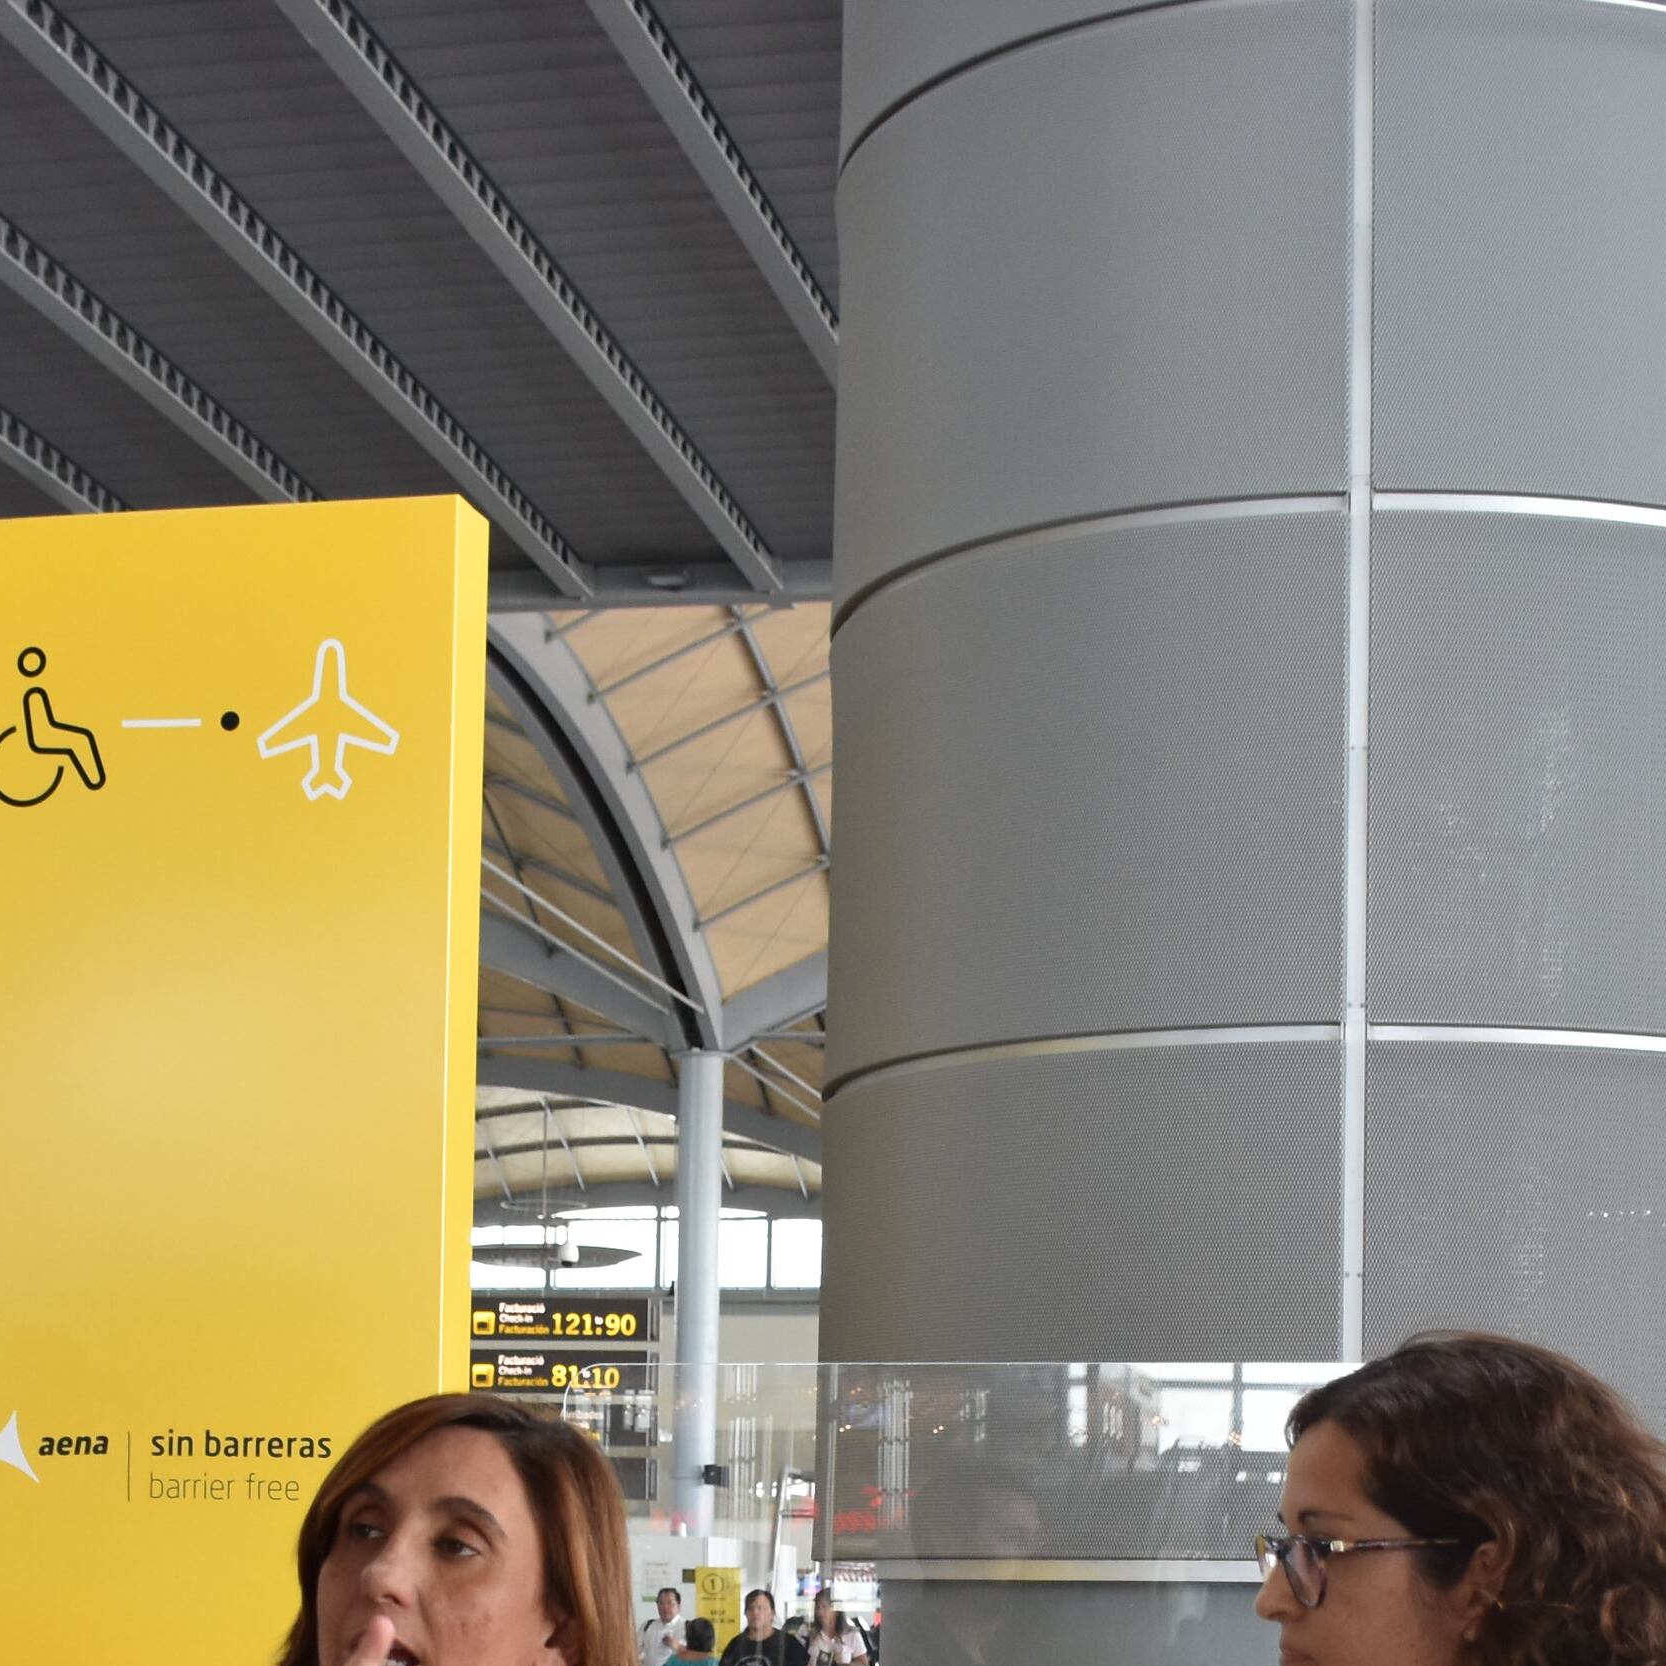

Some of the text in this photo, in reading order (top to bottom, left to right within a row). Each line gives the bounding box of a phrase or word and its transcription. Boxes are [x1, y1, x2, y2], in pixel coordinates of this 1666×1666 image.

[498, 1303, 546, 1315] Facturació
[499, 1314, 534, 1323] Check-in
[498, 1324, 550, 1335] Facturación
[498, 1355, 545, 1367] Facturació
[498, 1366, 533, 1376] Check-in
[498, 1376, 549, 1387] Facturación
[38, 1434, 109, 1457] aena
[151, 1429, 332, 1459] sin barreras
[149, 1472, 300, 1501] barrier free
